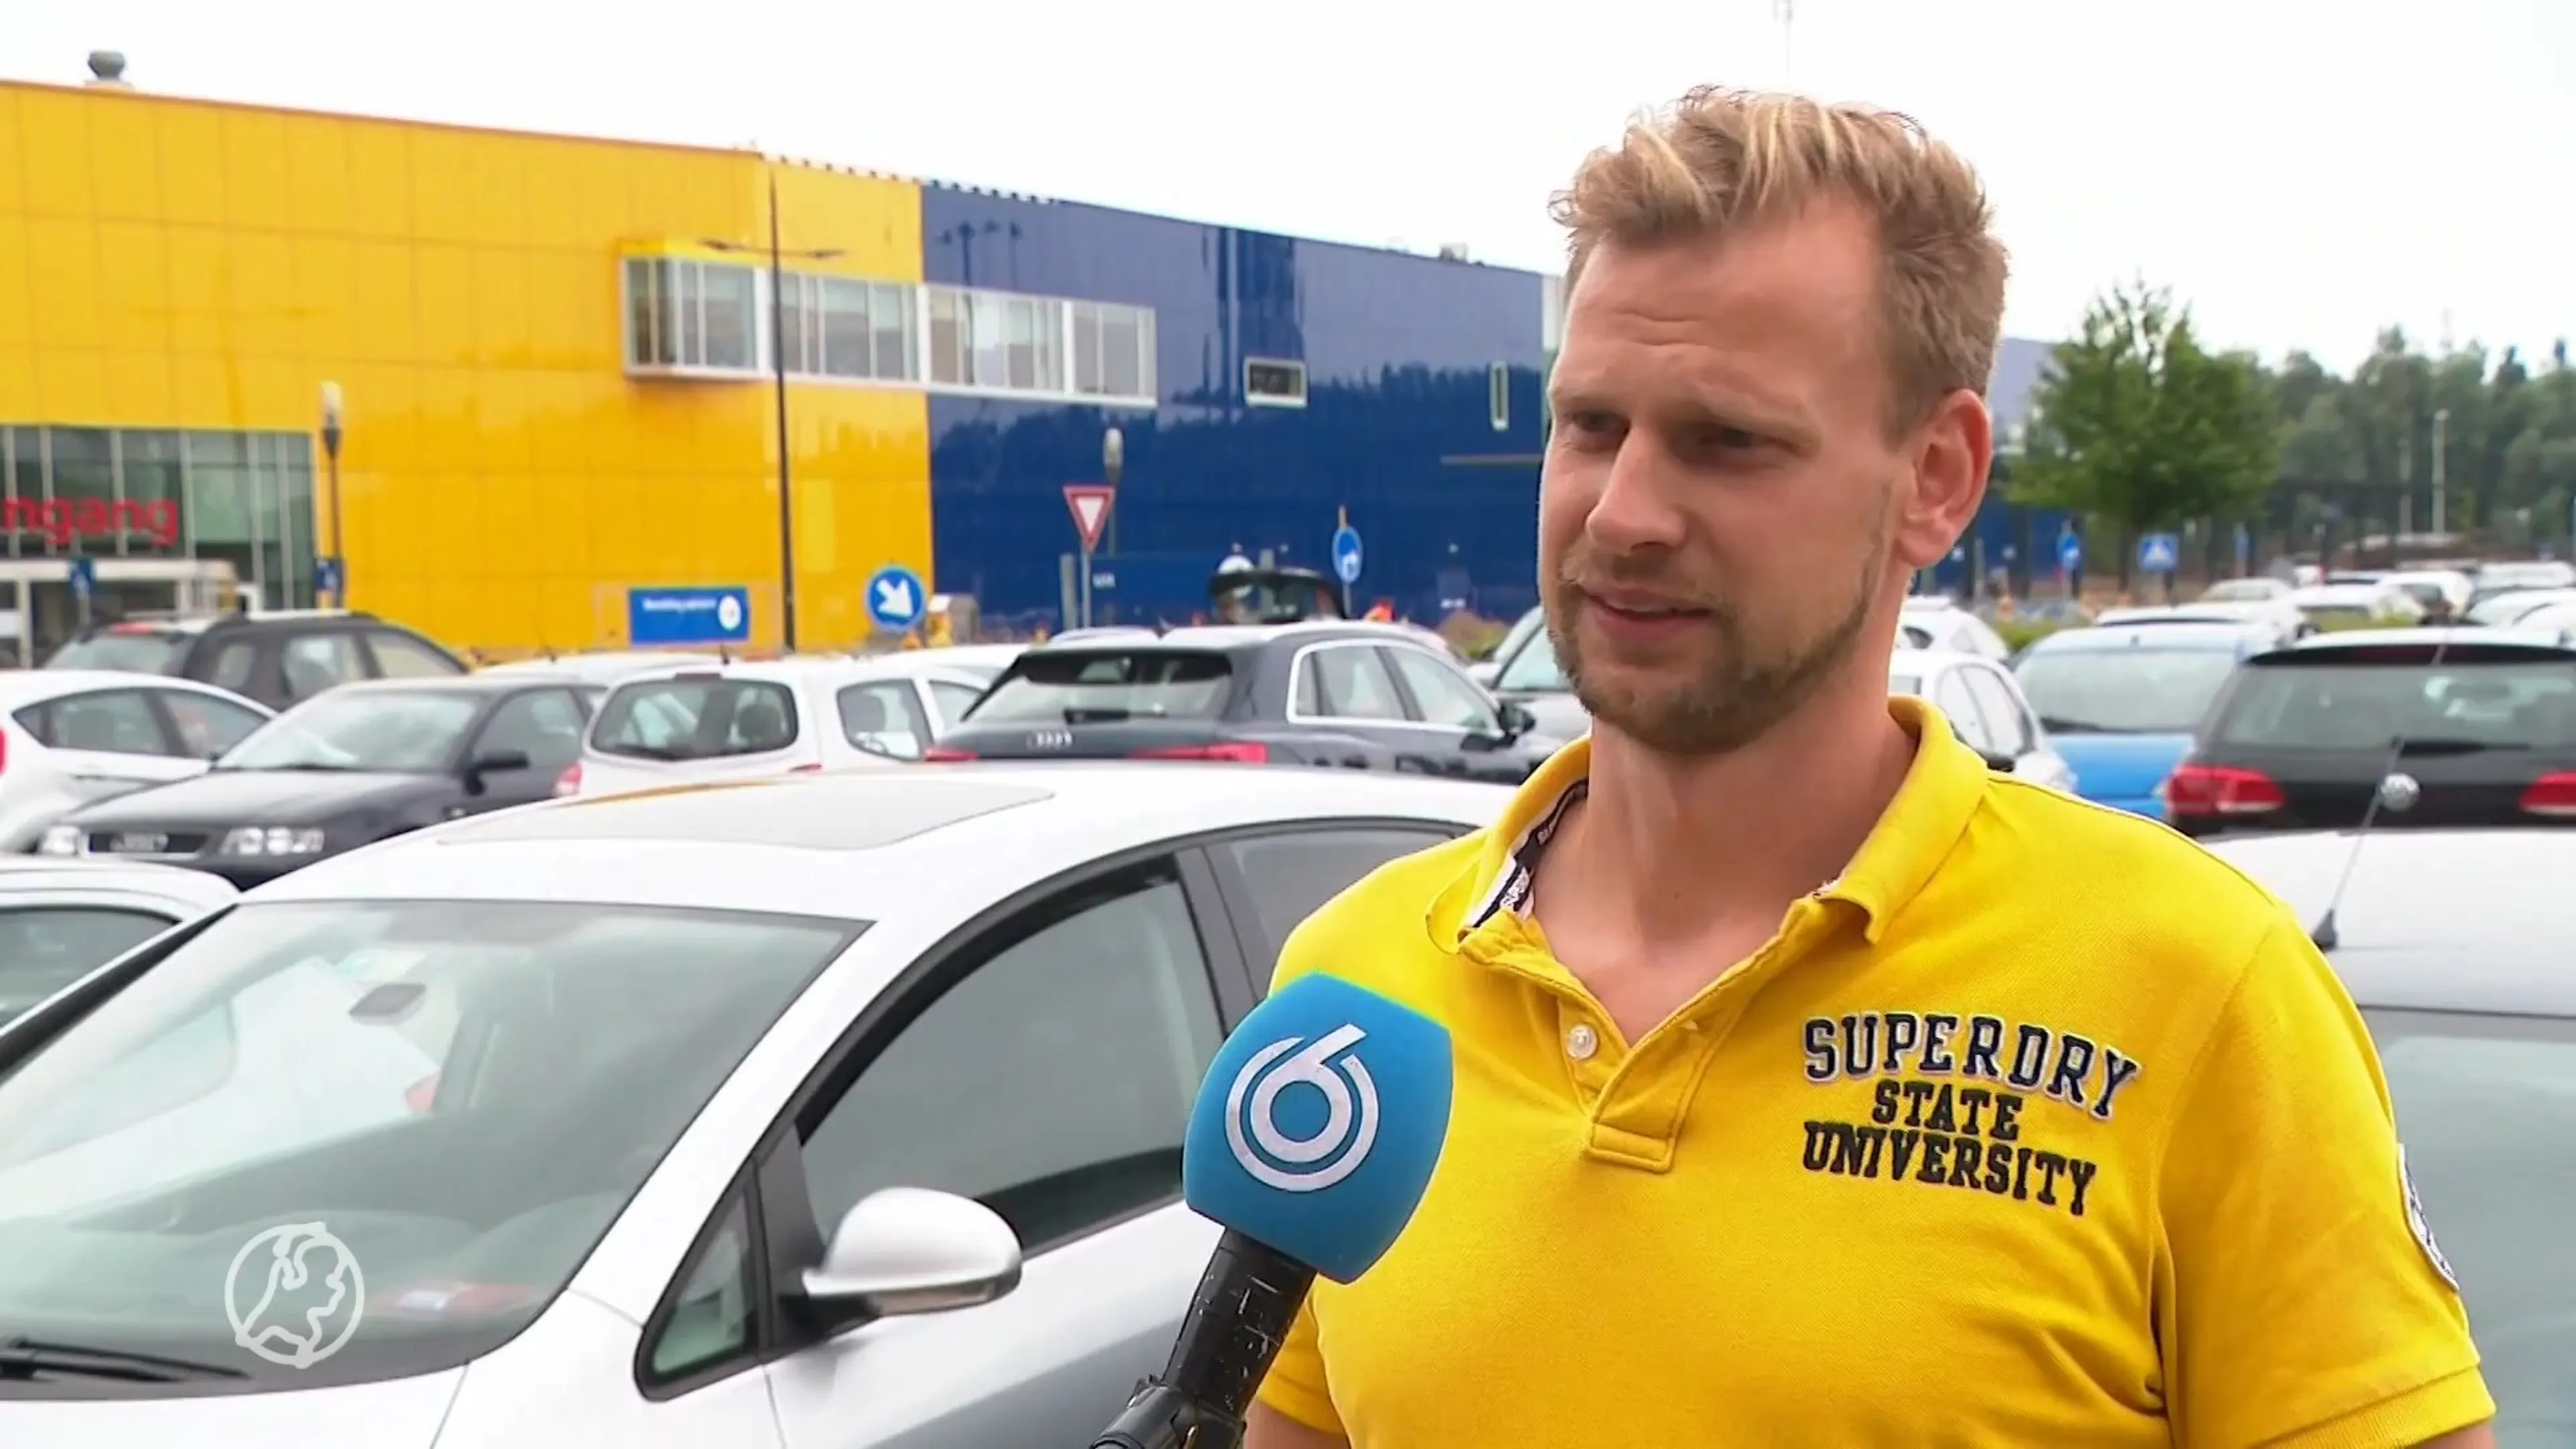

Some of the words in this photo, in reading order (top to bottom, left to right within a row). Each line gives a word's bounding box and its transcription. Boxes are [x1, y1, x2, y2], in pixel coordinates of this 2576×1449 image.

[3, 495, 180, 547] ngang
[1803, 1011, 2141, 1120] SUPERDRY
[1872, 1078, 2024, 1141] STATE
[1803, 1120, 2097, 1216] UNIVERSITY
